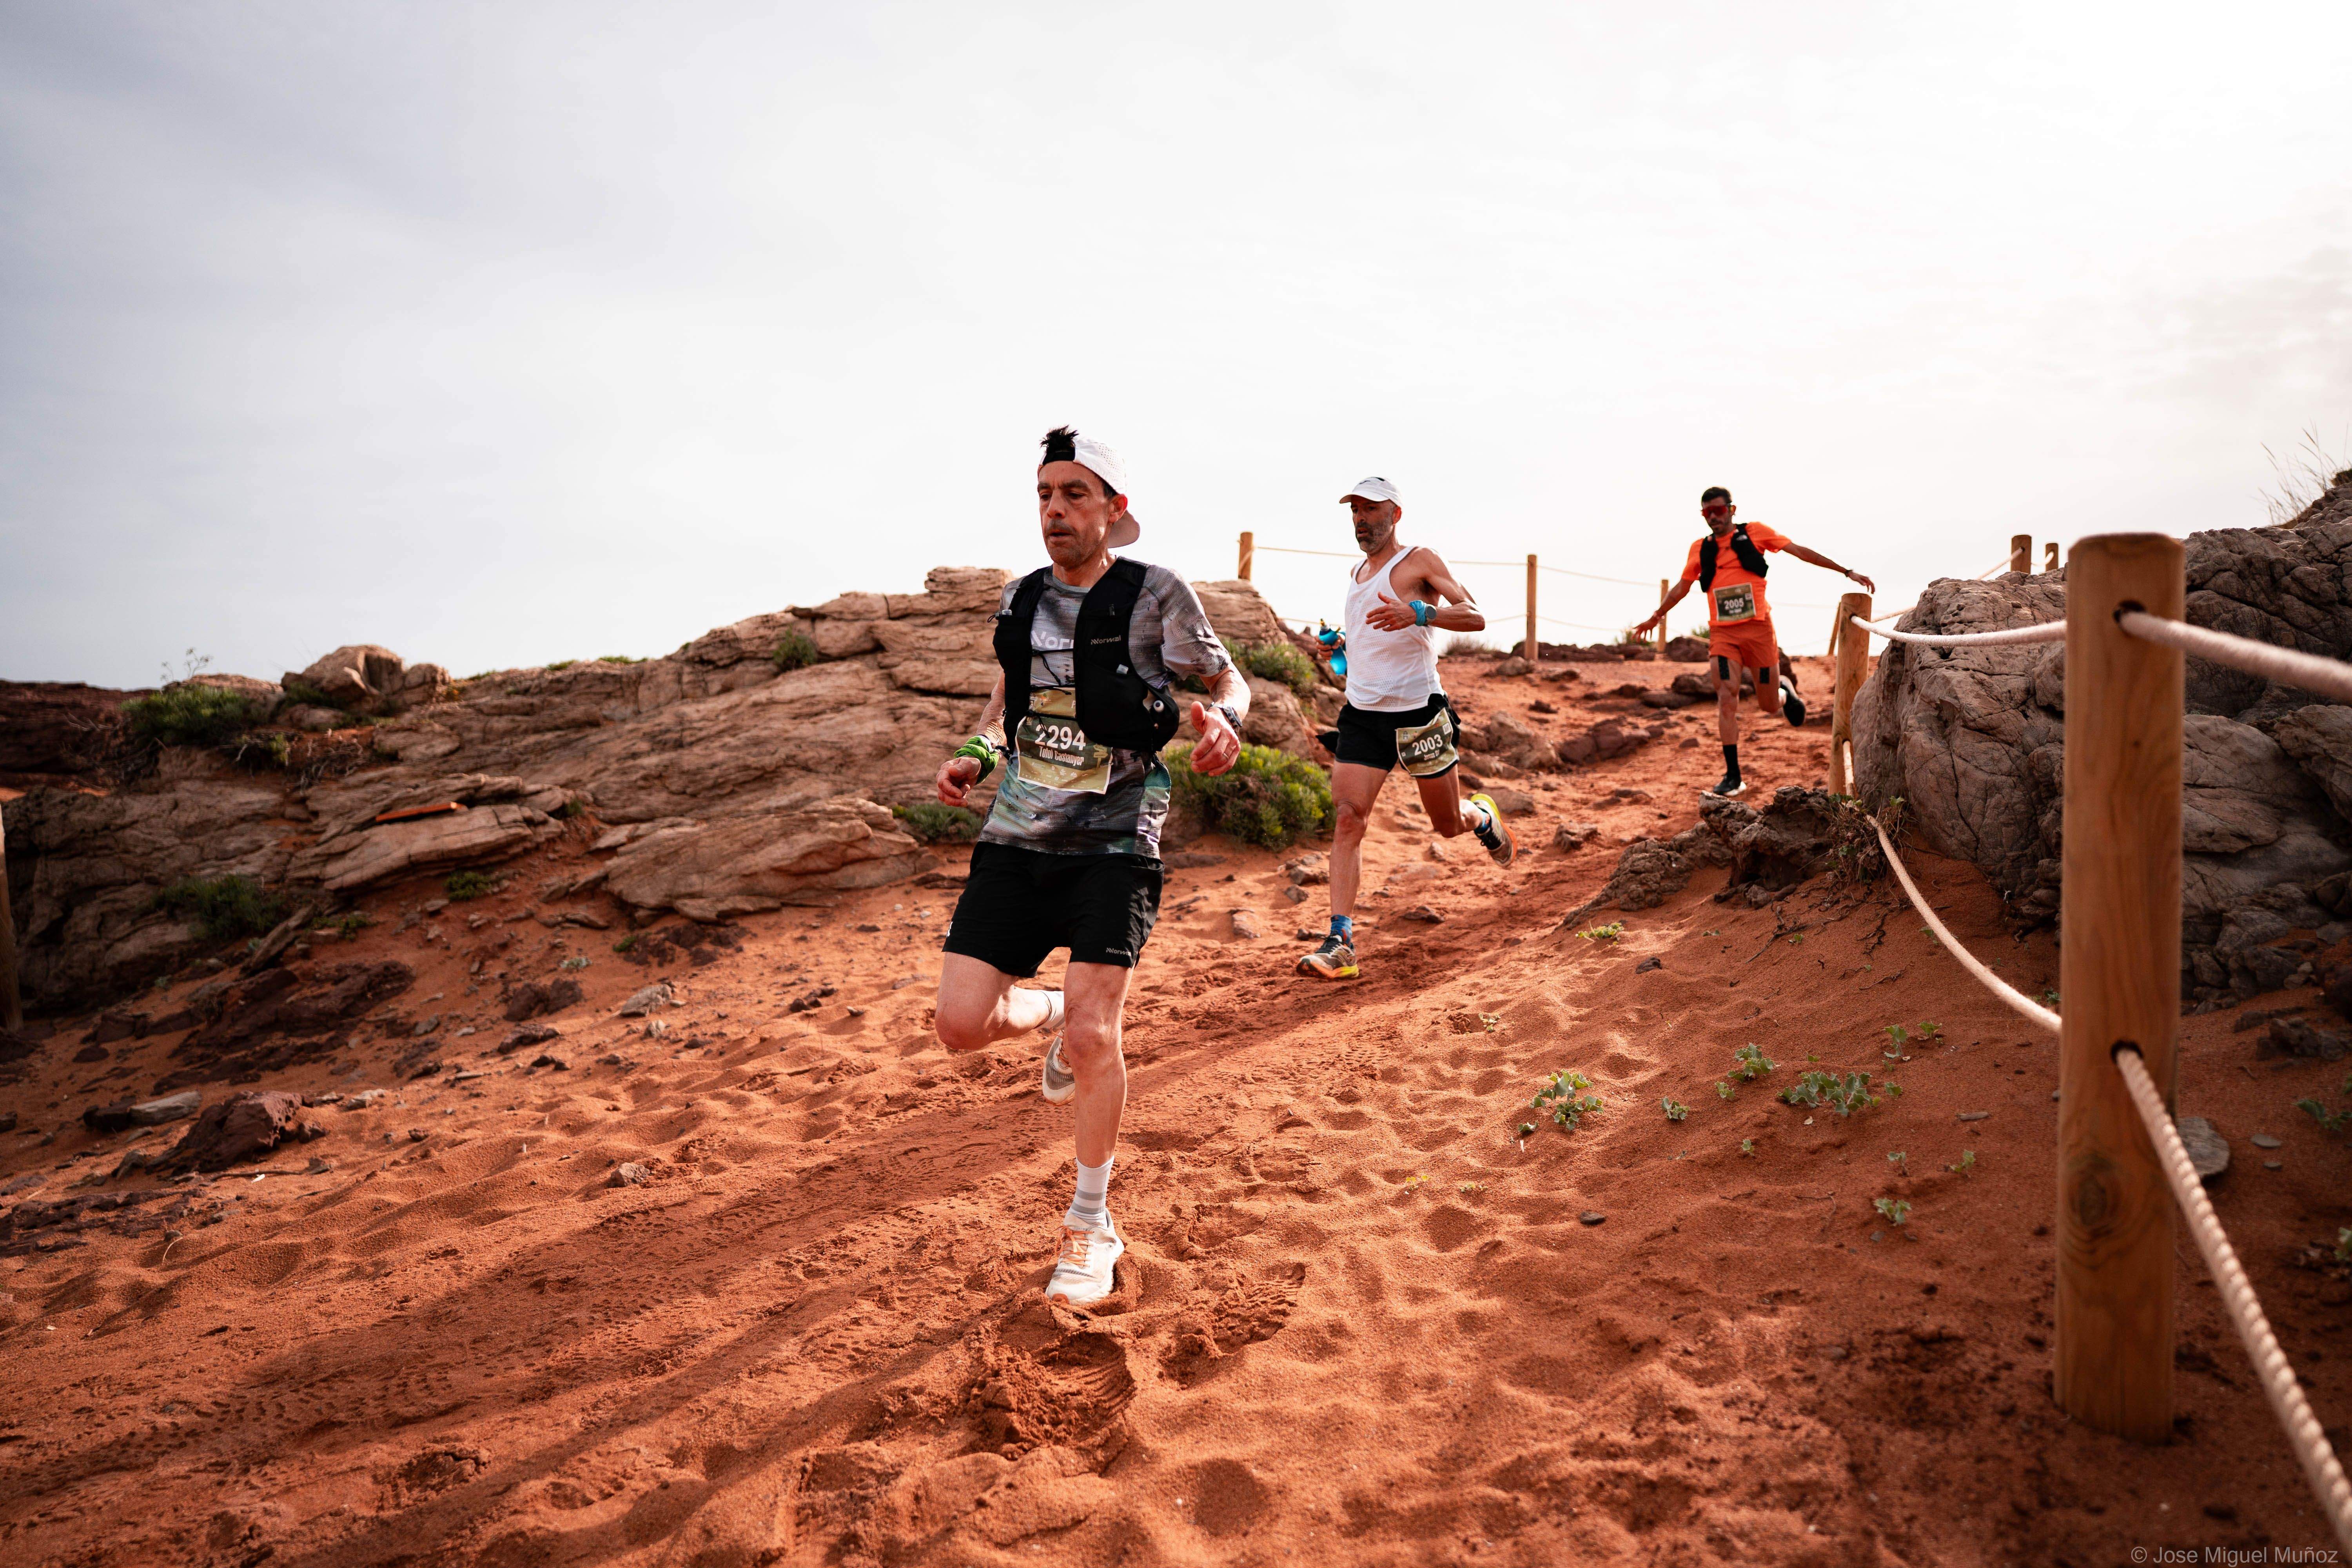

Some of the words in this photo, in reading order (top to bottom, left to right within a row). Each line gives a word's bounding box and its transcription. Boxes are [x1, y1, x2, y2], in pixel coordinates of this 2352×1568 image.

[1724, 597, 1744, 610] 2005
[1035, 724, 1086, 750] 2294
[1412, 734, 1443, 756] 2003
[1054, 750, 1084, 766] Castanyer
